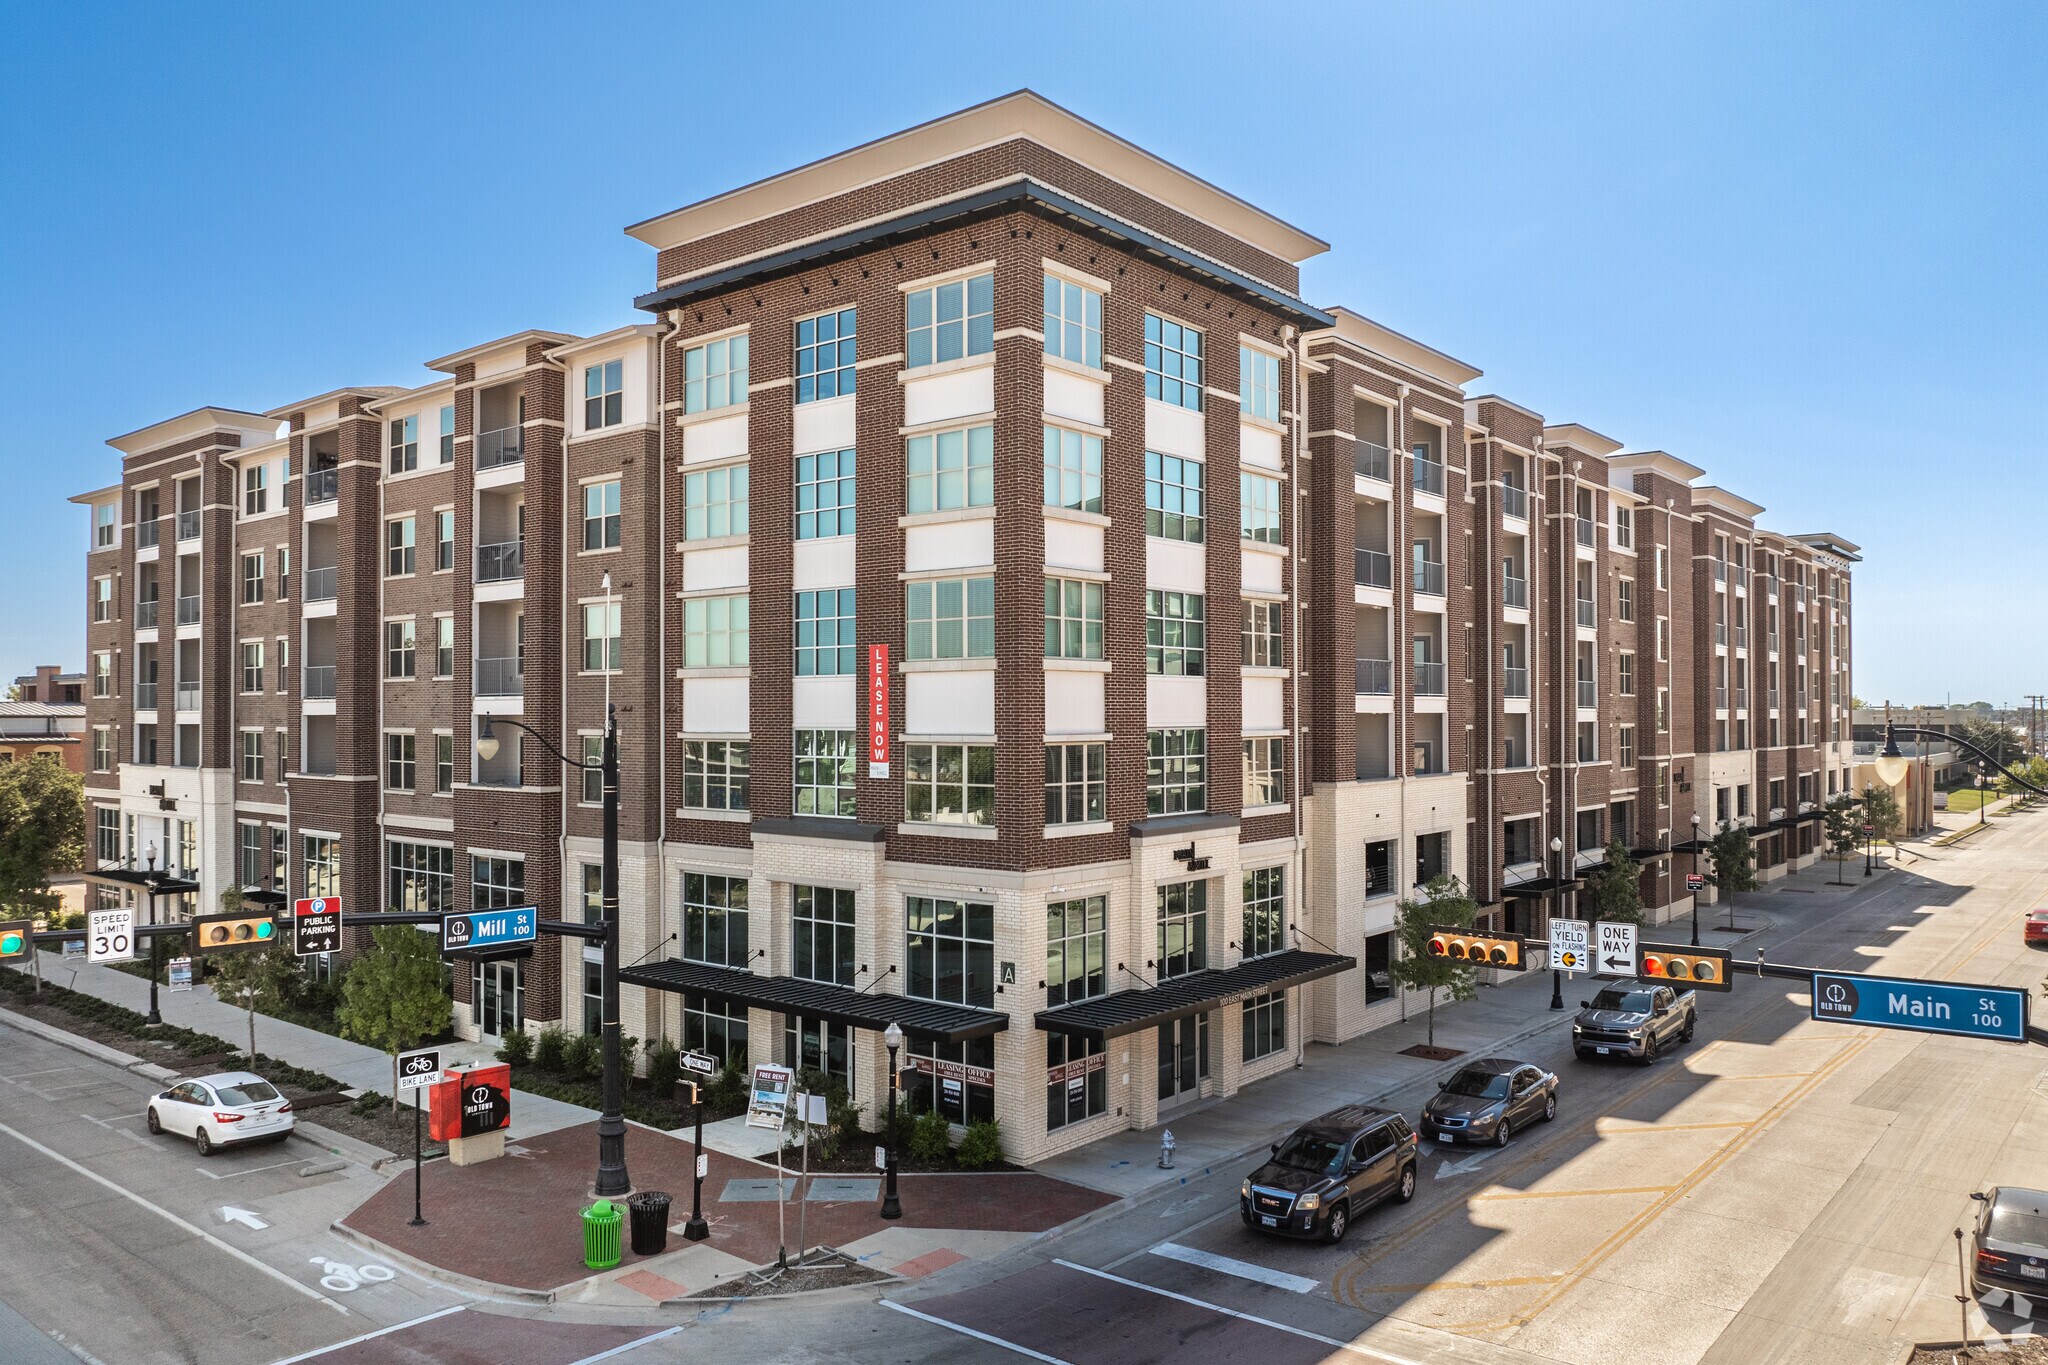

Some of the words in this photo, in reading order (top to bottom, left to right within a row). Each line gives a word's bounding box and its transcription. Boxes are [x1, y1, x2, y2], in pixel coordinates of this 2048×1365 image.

[875, 649, 883, 715] LEASE
[874, 721, 885, 760] NOW
[93, 914, 130, 924] SPEED
[304, 916, 333, 926] PUBLIC
[97, 924, 125, 934] LIMIT
[301, 925, 336, 936] PARKING
[478, 919, 506, 937] Mill
[517, 914, 527, 924] St
[513, 926, 530, 935] 100
[1552, 922, 1566, 930] LEFT
[1571, 924, 1587, 932] TURN
[1555, 931, 1583, 942] YIELD
[1603, 927, 1629, 940] ONE
[95, 935, 128, 954] 30
[1562, 942, 1586, 952] FLASHING
[1603, 940, 1630, 953] WAY
[1004, 967, 1014, 983] A
[1229, 993, 1240, 1003] EAST
[1240, 990, 1252, 1000] MAIN
[1253, 986, 1268, 997] STREET
[1821, 1002, 1833, 1011] OLD
[1834, 1003, 1852, 1013] TOWN
[1888, 992, 1950, 1020] Main
[1979, 998, 1995, 1012] St
[1972, 1013, 2002, 1028] 100
[690, 1059, 699, 1067] ONE
[937, 1061, 964, 1073] LEASING
[967, 1068, 990, 1079] OFFICE
[402, 1077, 416, 1087] BIKE
[419, 1074, 437, 1084] LANE
[759, 1072, 771, 1080] FREE
[772, 1073, 786, 1081] RENT
[467, 1105, 477, 1113] OLD
[478, 1102, 493, 1111] TOWN
